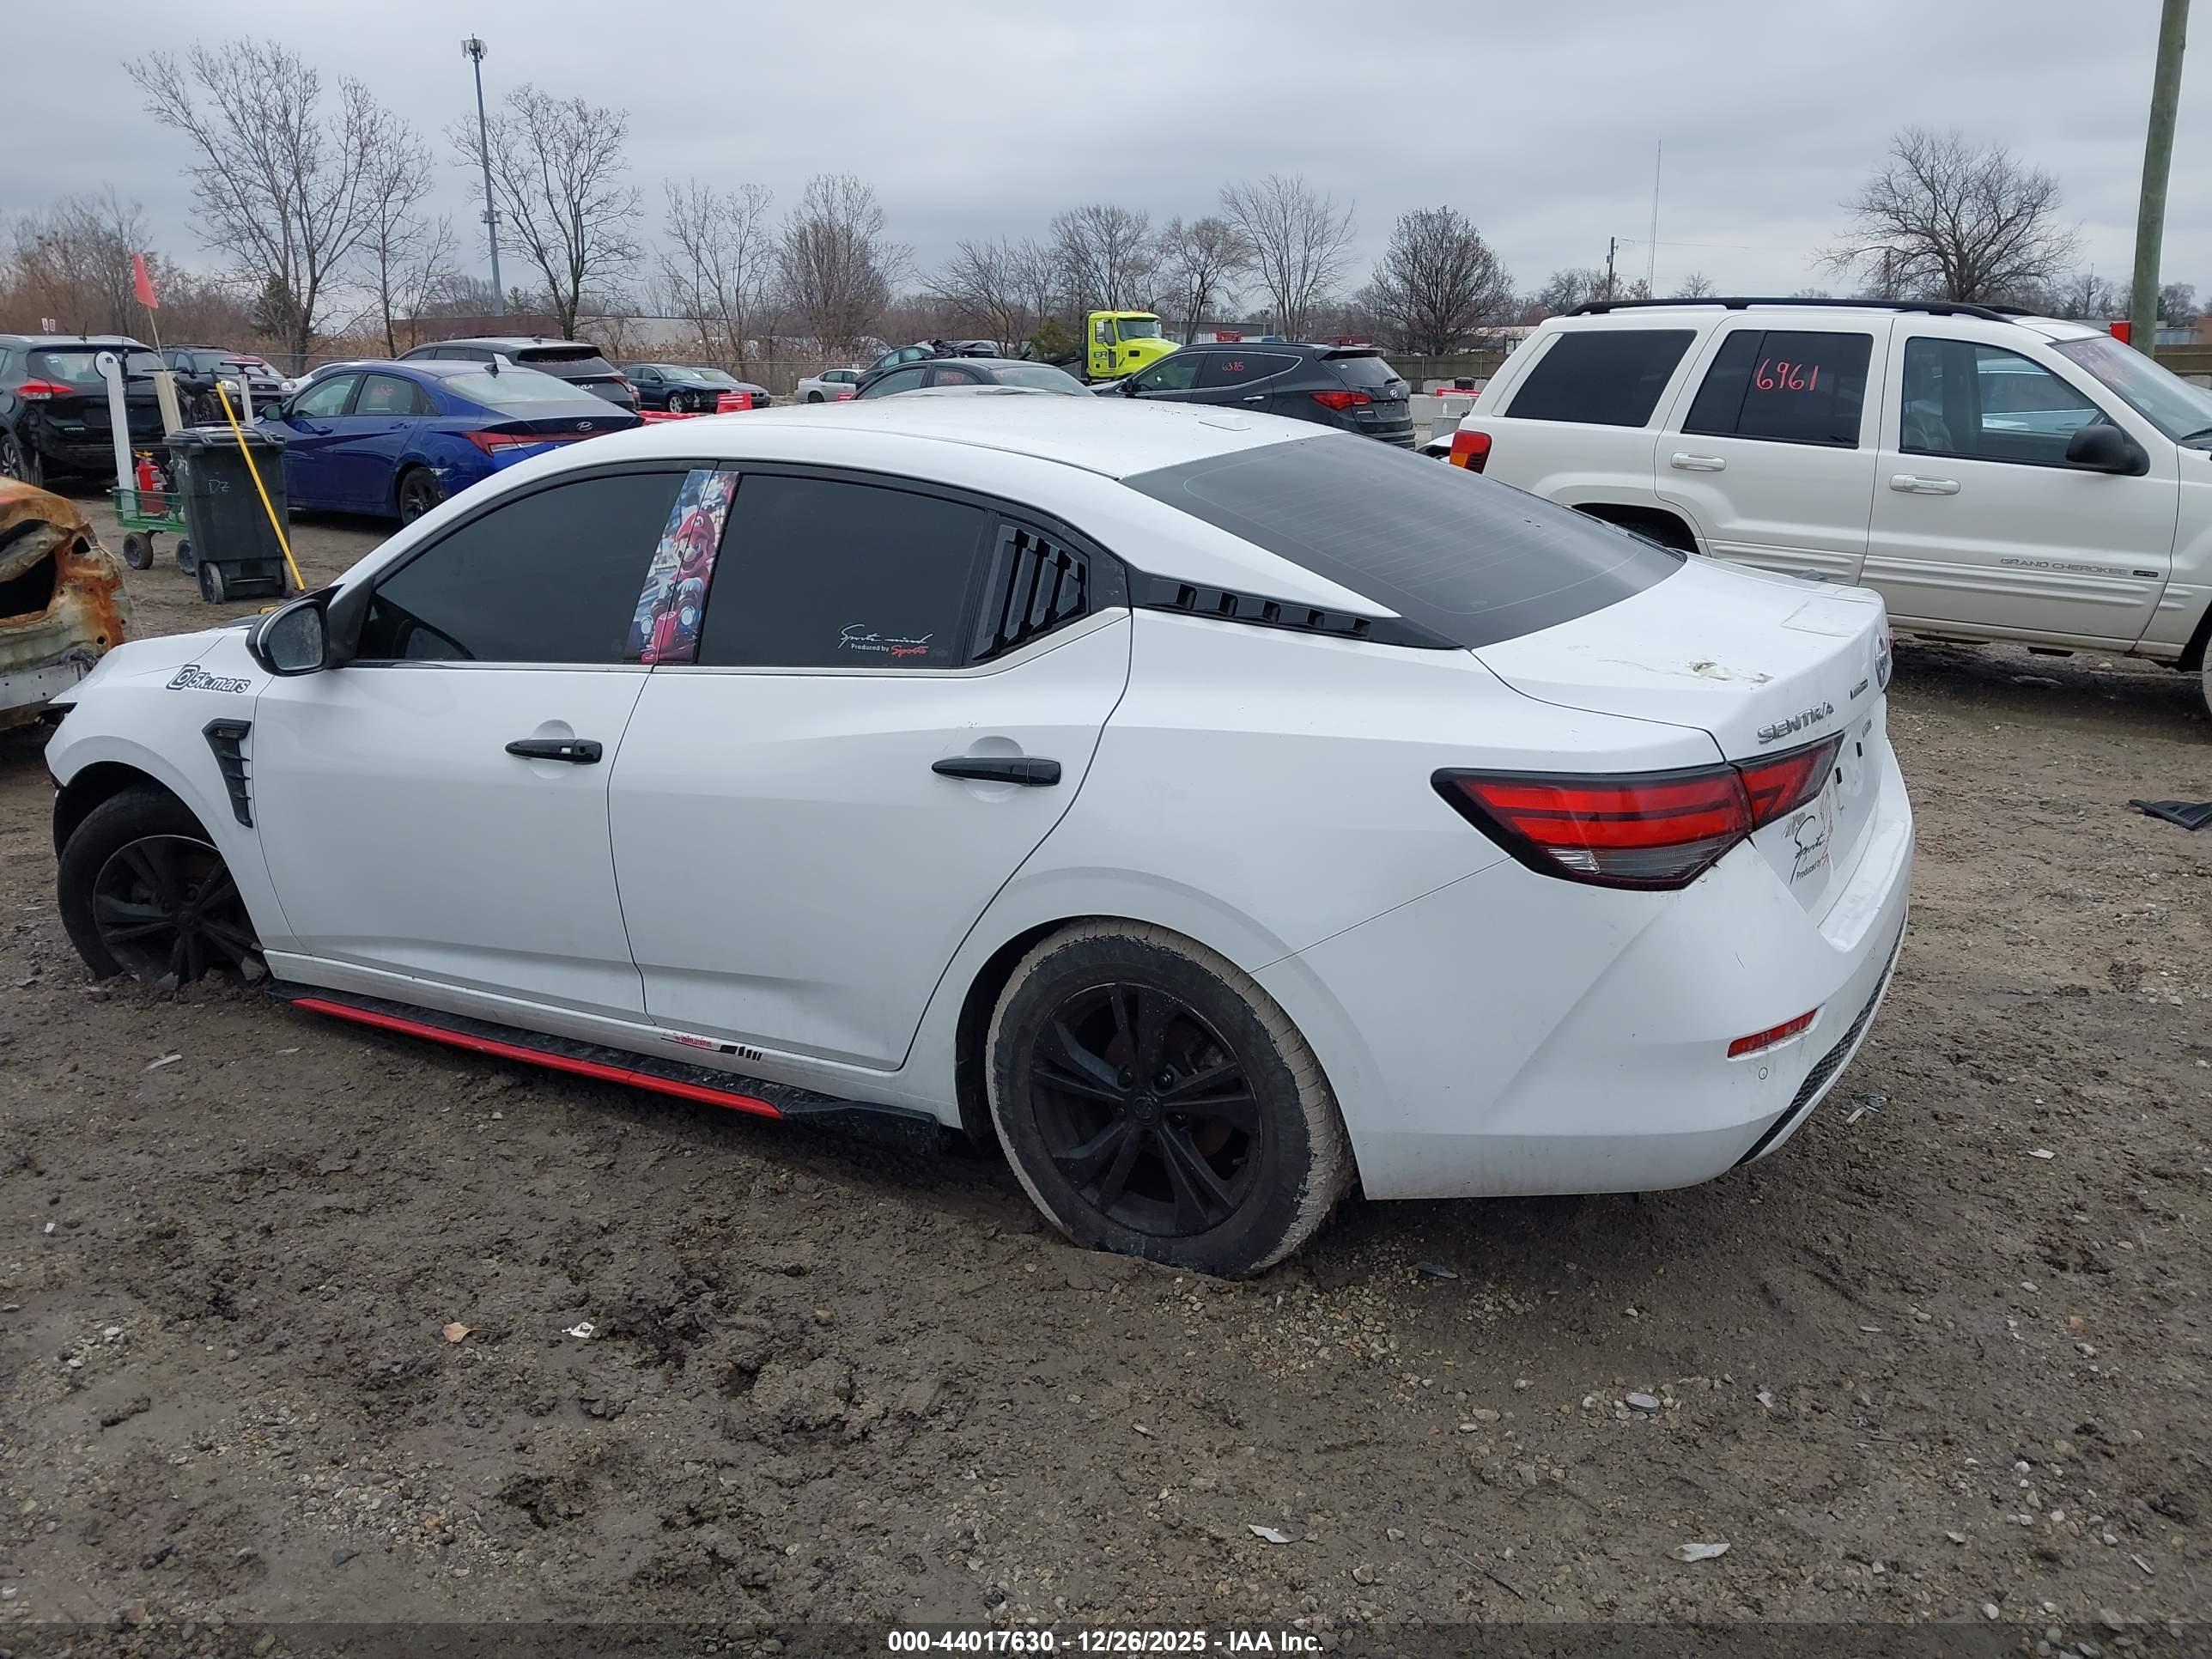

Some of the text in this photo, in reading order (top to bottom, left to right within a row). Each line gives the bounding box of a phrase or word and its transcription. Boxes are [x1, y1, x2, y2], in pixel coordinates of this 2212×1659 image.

[1756, 357, 1820, 391] 6961
[2000, 558, 2049, 568] GRAND
[2052, 562, 2129, 575] CHEROKEE
[1758, 700, 1835, 744] SENTRA
